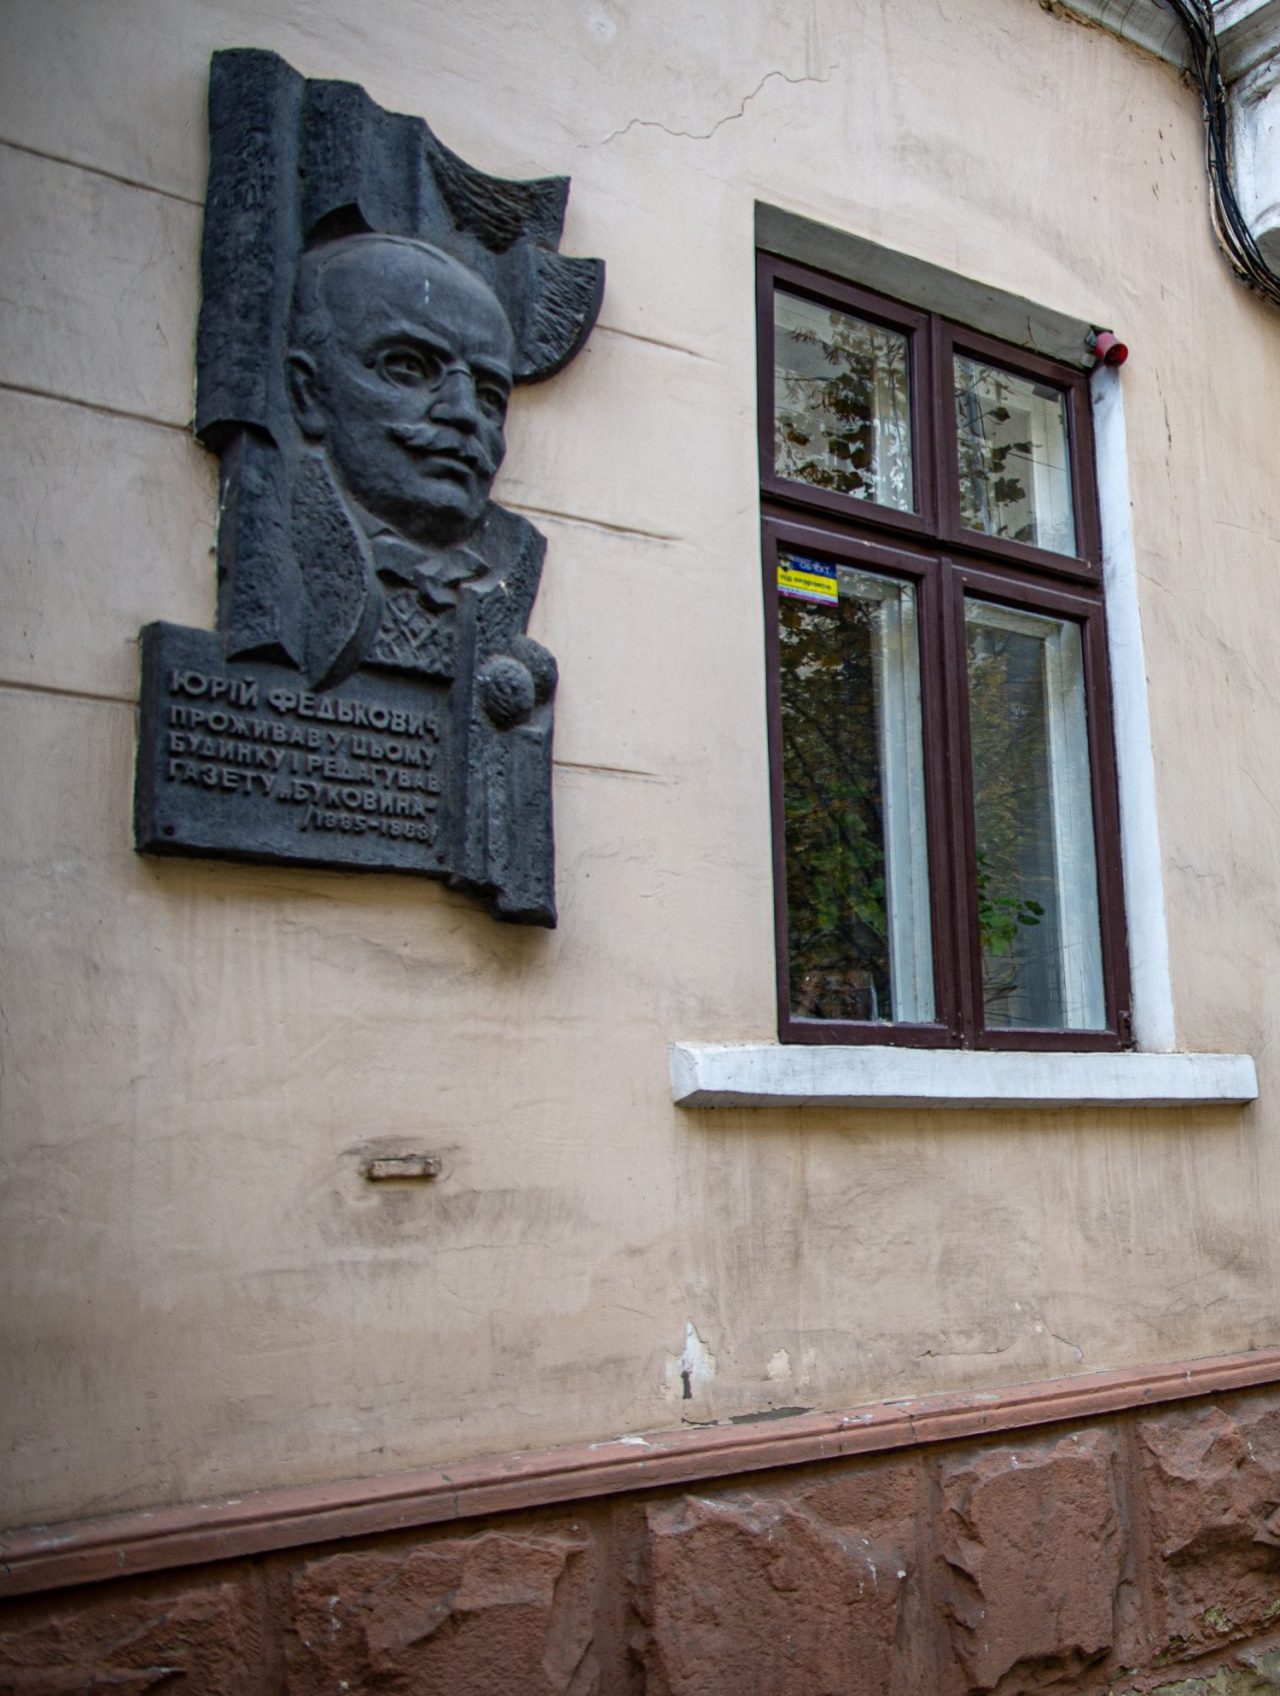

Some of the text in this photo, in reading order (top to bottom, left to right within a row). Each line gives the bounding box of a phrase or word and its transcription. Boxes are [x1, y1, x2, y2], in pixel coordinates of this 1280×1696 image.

[170, 668, 439, 740] ЮРІЙ ФЕДЬКОВИЧ
[168, 731, 285, 769] БУДИНКУ
[306, 754, 440, 793] РЕДАГУВАВ
[169, 704, 436, 768] ПРОЖИВАВ У ЦЬОМУ
[168, 757, 276, 794] ГАЗЕТУ
